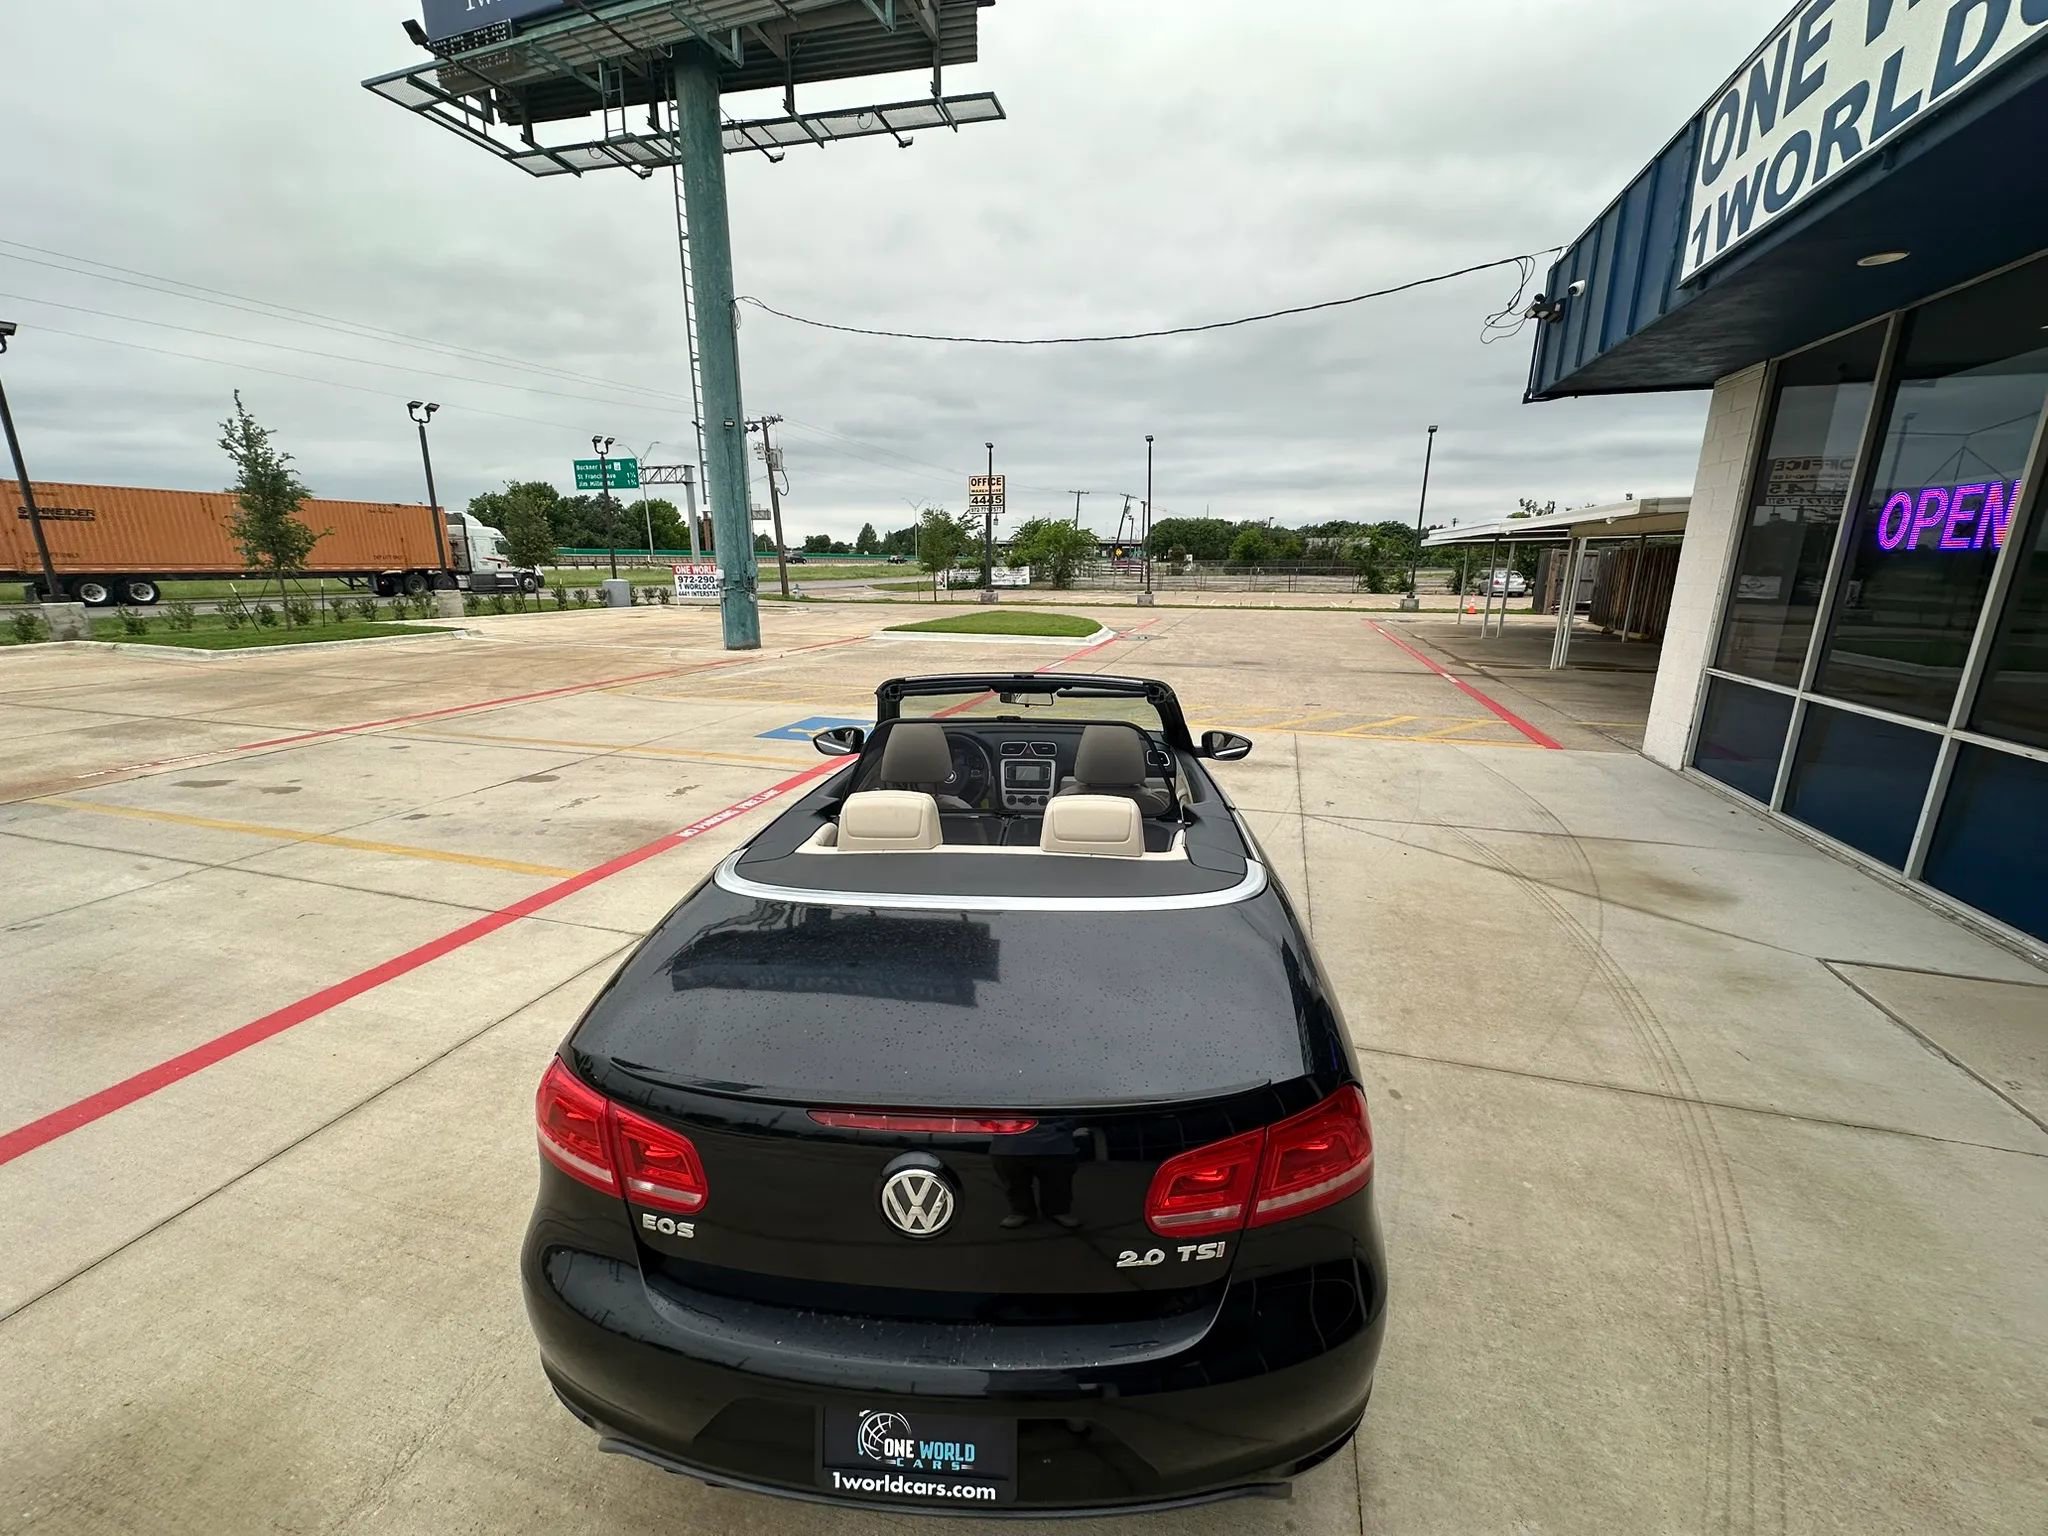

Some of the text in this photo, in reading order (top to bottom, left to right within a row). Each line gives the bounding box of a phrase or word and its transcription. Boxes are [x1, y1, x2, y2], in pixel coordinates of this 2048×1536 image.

[1702, 0, 1835, 187] ONE
[1690, 0, 2048, 269] 1WORLD
[970, 477, 1002, 486] OFFICE
[17, 506, 96, 517] SHNEIDER
[1878, 479, 2022, 550] OPEN
[675, 565, 691, 574] ONE
[676, 828, 701, 838] NO
[642, 1213, 695, 1239] EOS
[1116, 1248, 1166, 1267] 2.0
[884, 1438, 976, 1462] ONE WORLD
[896, 1457, 962, 1471] CARS
[832, 1471, 997, 1500] 1worldcars.com
